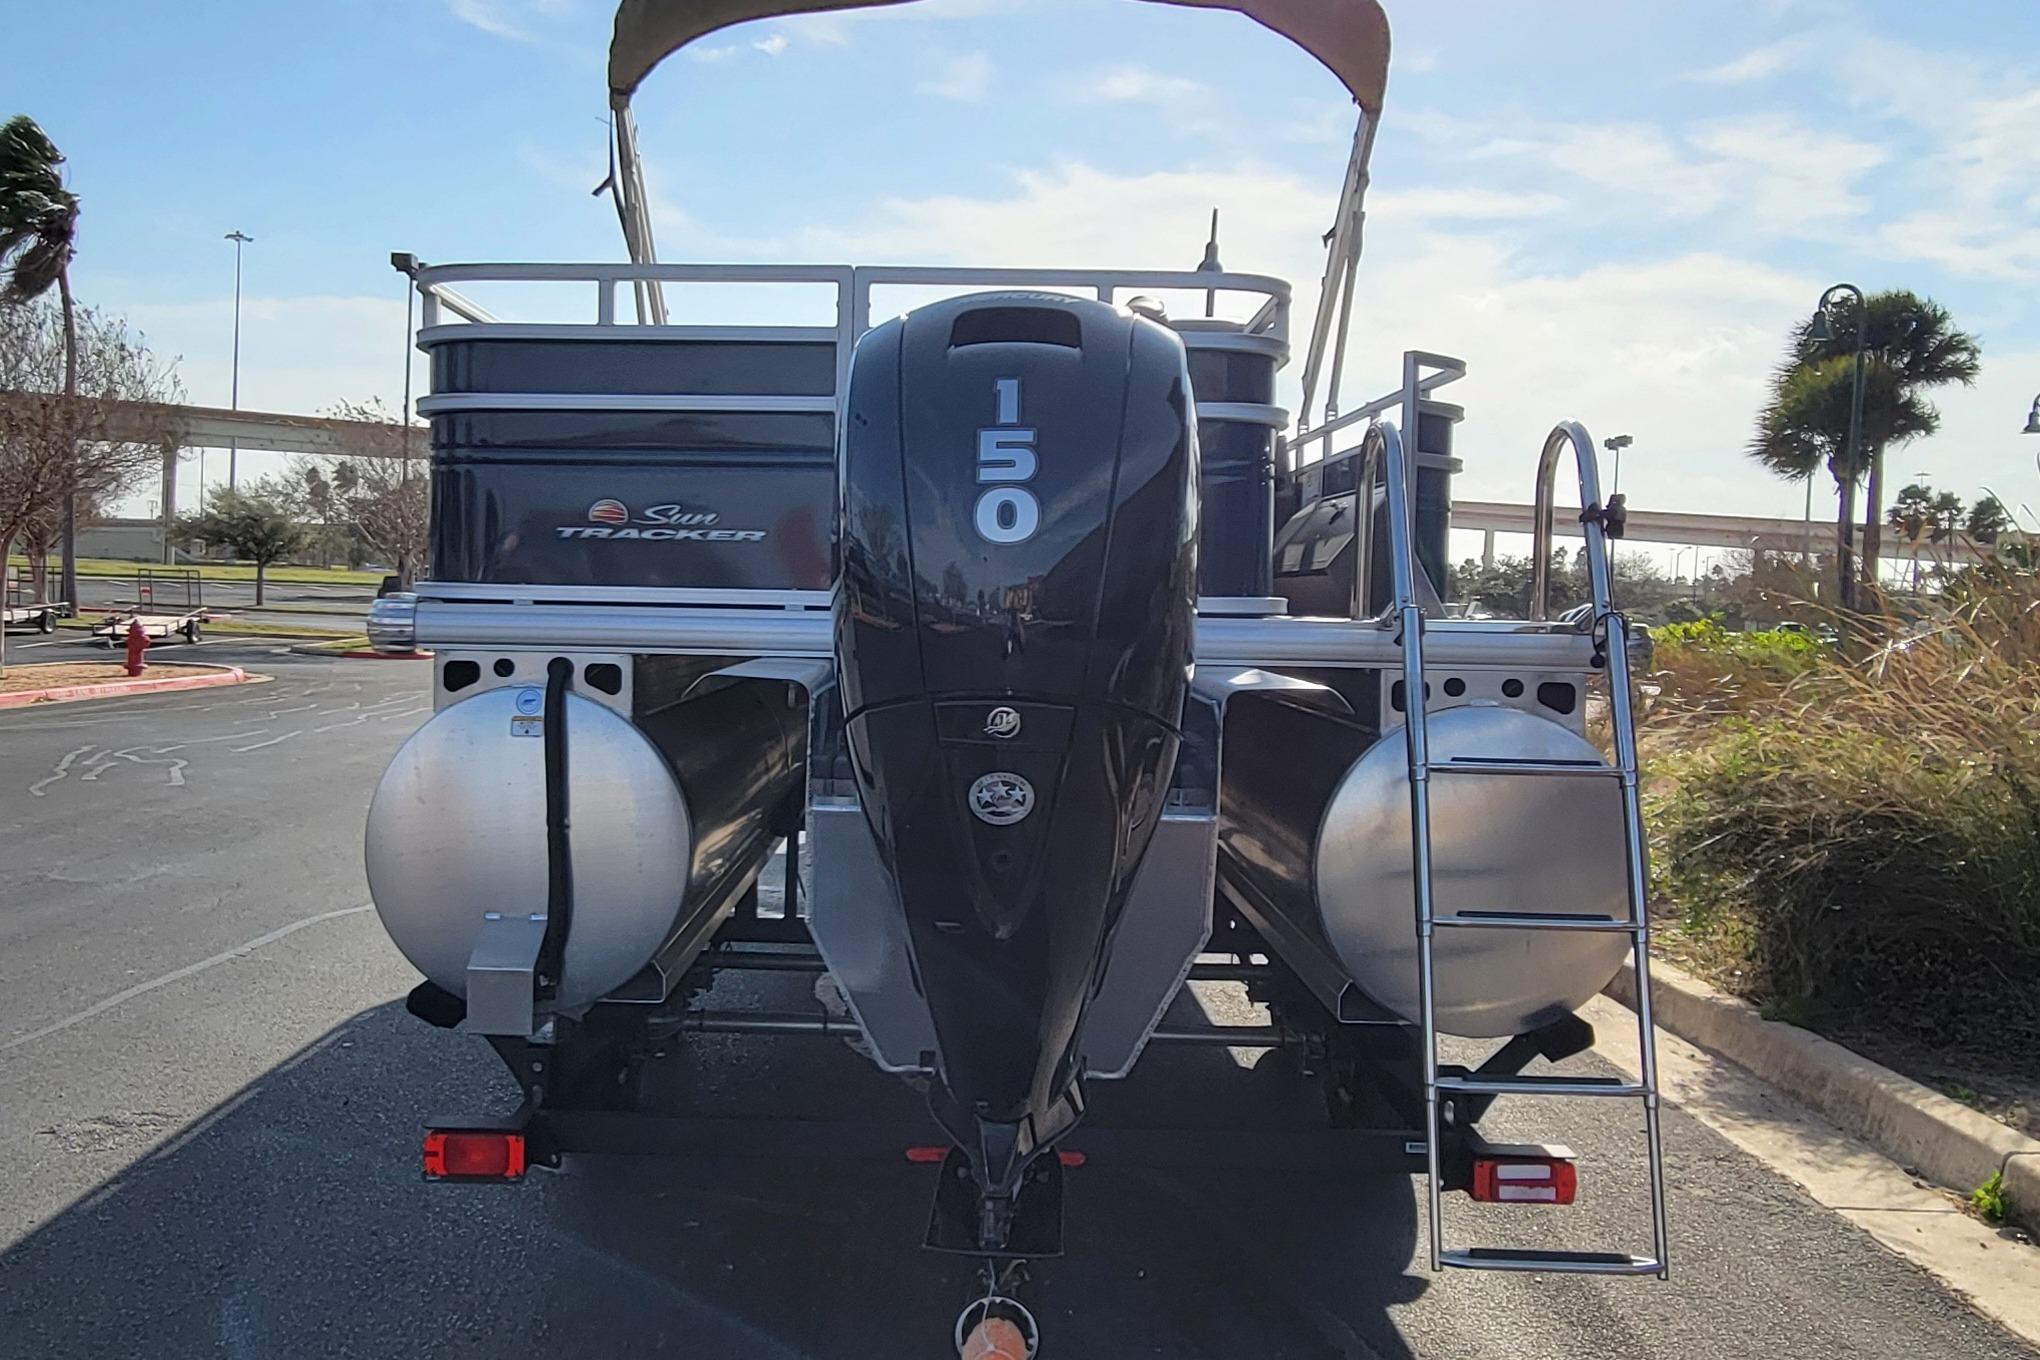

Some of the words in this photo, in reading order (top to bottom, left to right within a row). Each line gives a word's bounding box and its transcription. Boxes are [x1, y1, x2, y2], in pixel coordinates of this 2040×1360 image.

[975, 378, 1040, 543] 150
[632, 504, 721, 525] Sun
[555, 527, 767, 541] TRACKER
